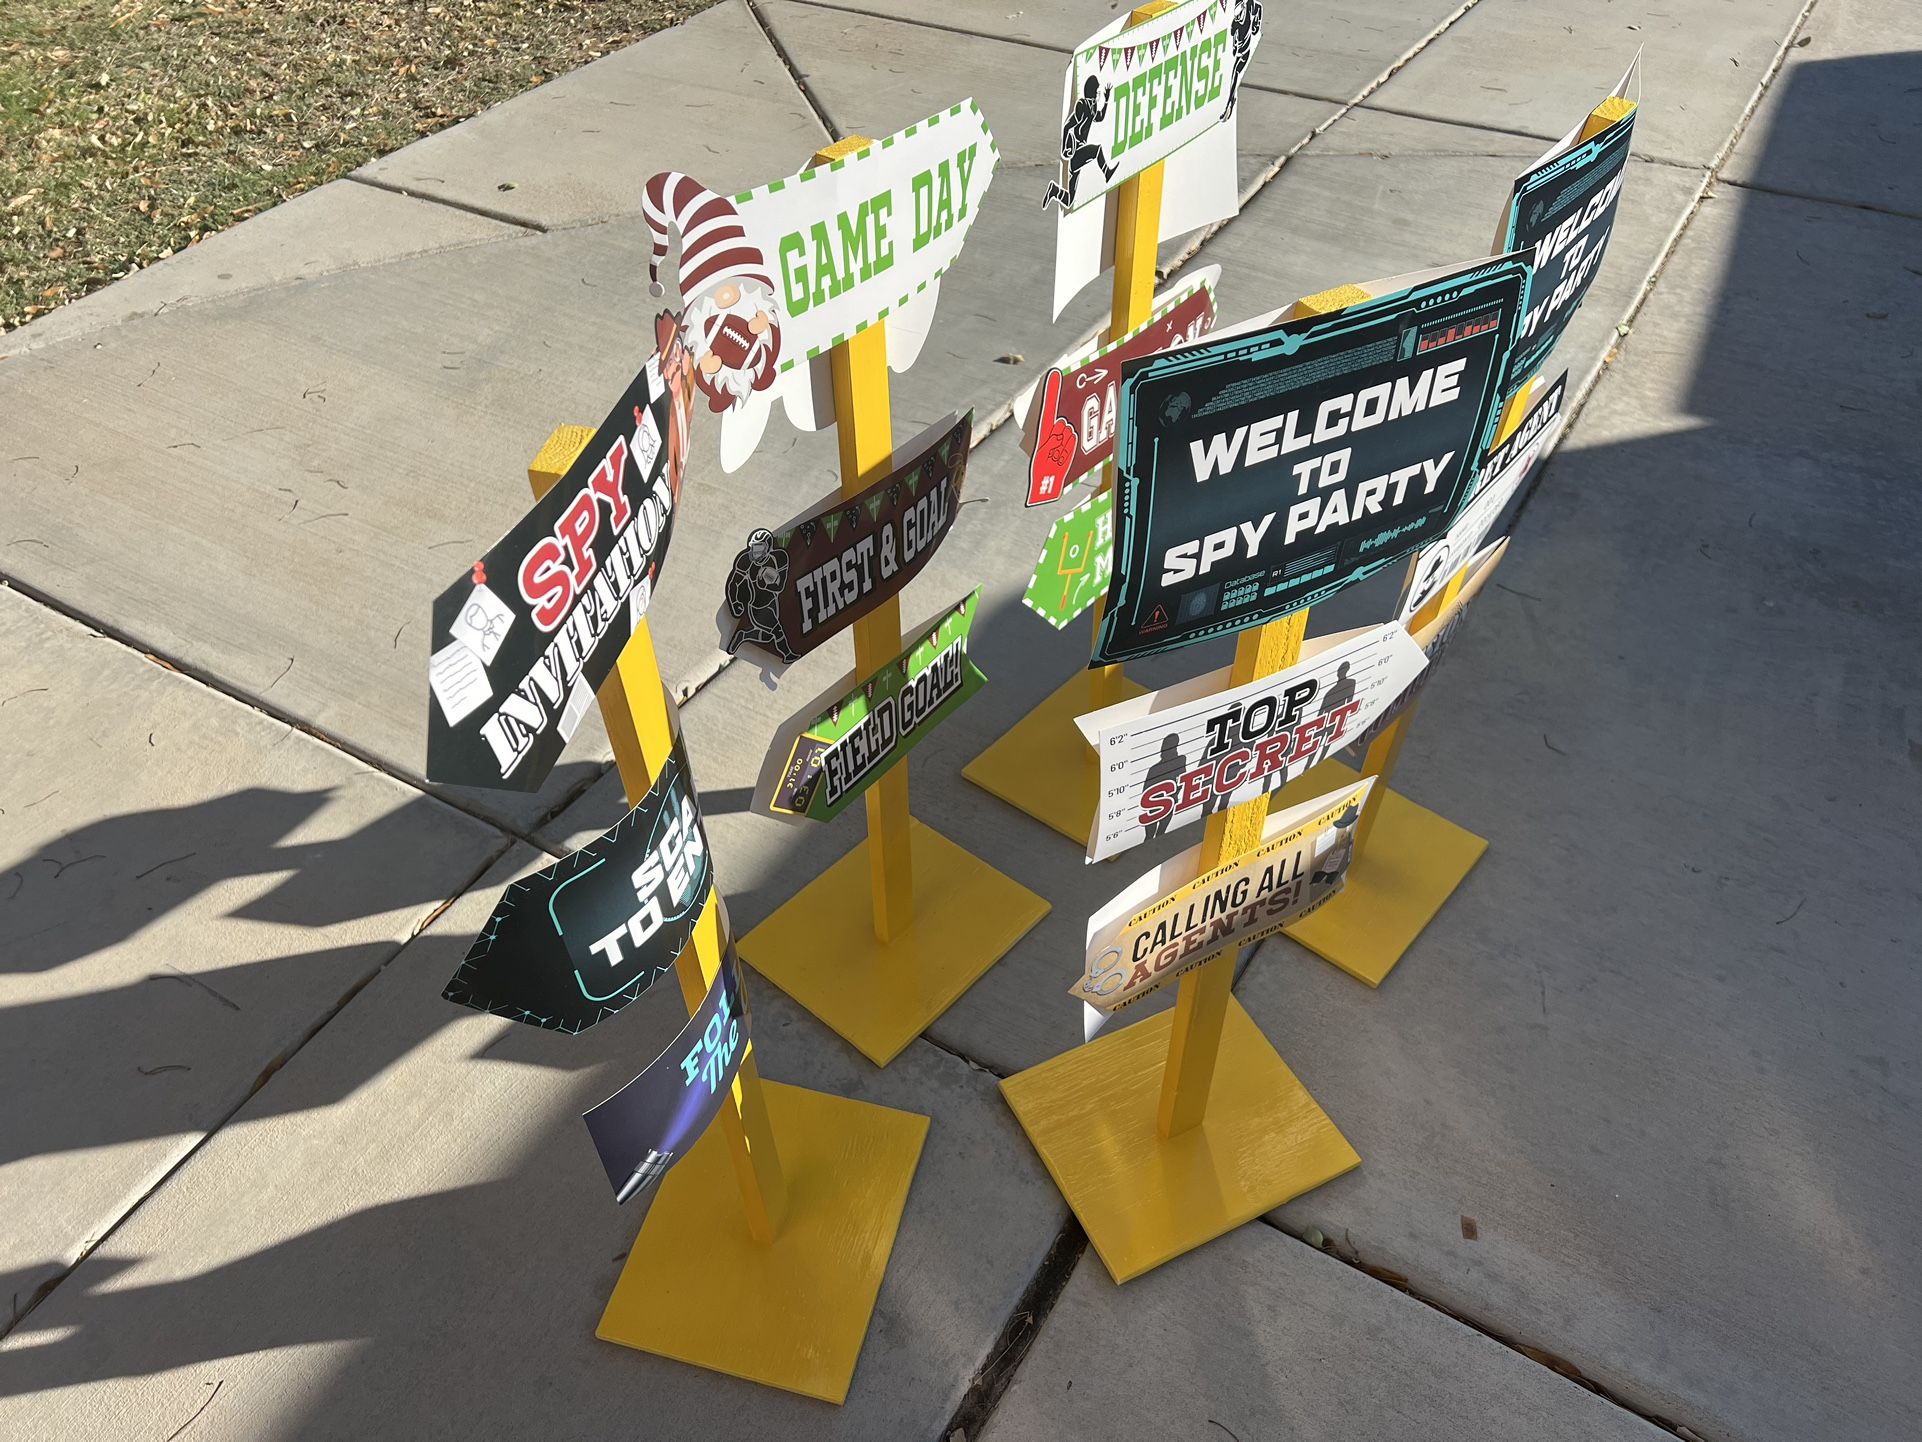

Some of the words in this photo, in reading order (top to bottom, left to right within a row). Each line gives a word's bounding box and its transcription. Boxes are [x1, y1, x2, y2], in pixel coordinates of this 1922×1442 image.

[1111, 28, 1228, 160] DEFENSE
[779, 189, 895, 318] GAME
[911, 142, 978, 253] DAY
[1560, 233, 1590, 280] TO
[1189, 357, 1468, 483] WELCOME
[1292, 447, 1352, 496] TO
[518, 435, 632, 633] SPY
[1039, 474, 1055, 495] #1
[1160, 512, 1275, 589] SPY
[1283, 450, 1456, 546] PARTY
[796, 535, 874, 634] FIRST
[880, 522, 897, 580] &
[903, 476, 950, 563] GOAL
[1225, 569, 1266, 589] Database
[480, 460, 674, 780] INVITATION
[820, 696, 897, 805] FIELD
[899, 634, 963, 737] GOAL!
[1137, 699, 1363, 826] SECRET
[1205, 677, 1321, 758] TOP
[589, 895, 664, 967] TO
[1128, 895, 1178, 928] CAUTION
[1192, 859, 1241, 890] CAUTION
[1256, 829, 1304, 858] CAUTION
[1131, 877, 1250, 964] CALLING
[1256, 851, 1305, 899] ALL
[1112, 982, 1161, 1012] CAUTION
[1175, 949, 1222, 977] CAUTION
[1237, 920, 1285, 947] CAUTION
[1123, 881, 1303, 992] AGENTS!
[701, 1019, 739, 1095] The
